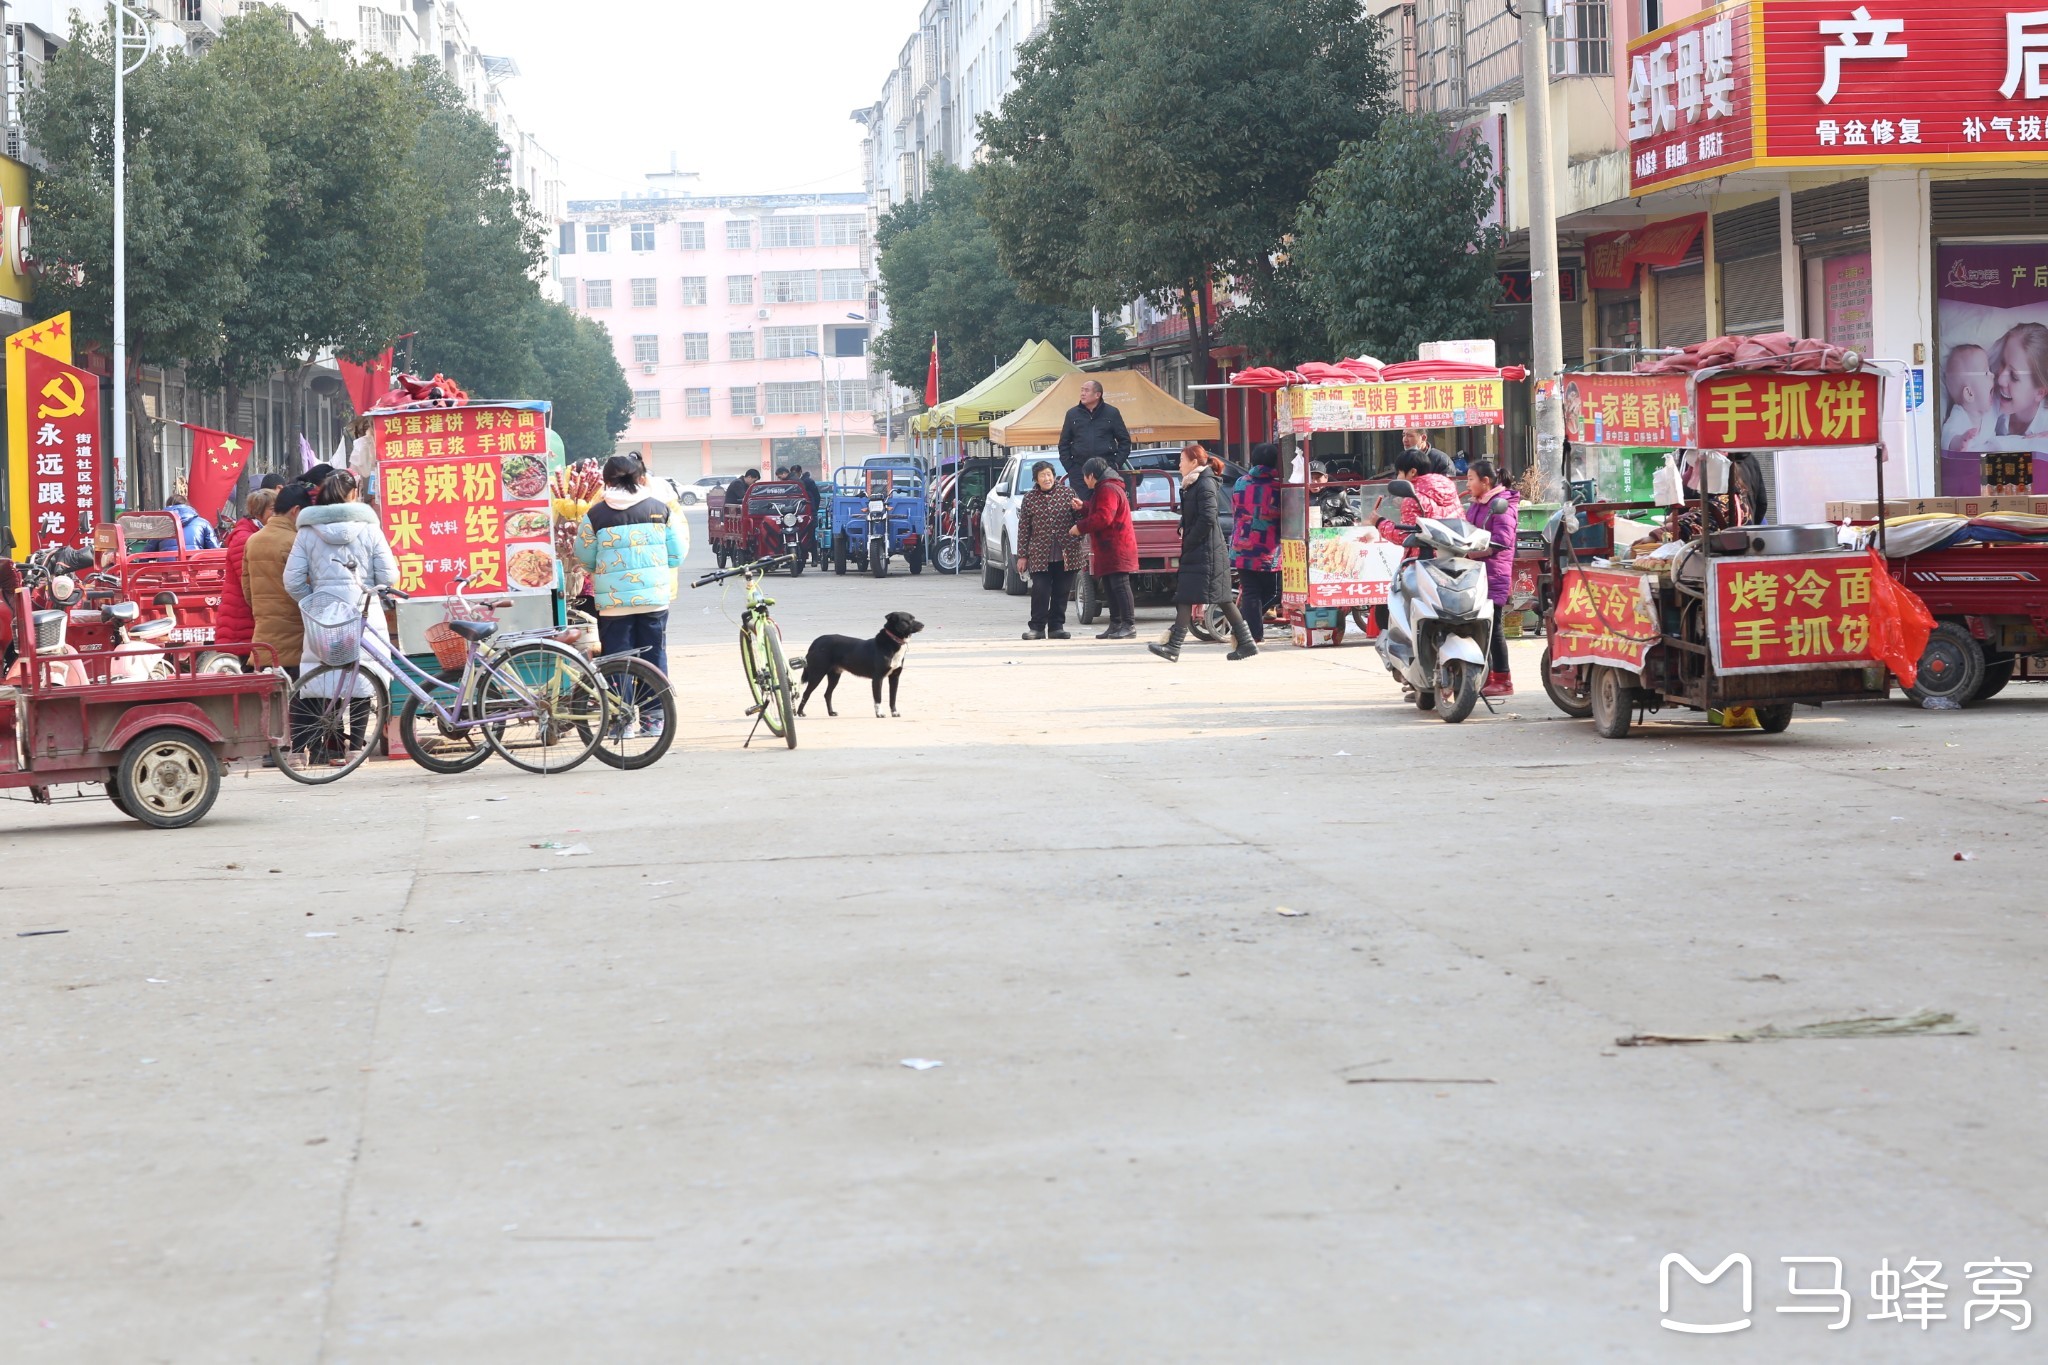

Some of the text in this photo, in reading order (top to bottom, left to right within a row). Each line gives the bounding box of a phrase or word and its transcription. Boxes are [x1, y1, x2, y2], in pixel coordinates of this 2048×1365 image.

[1815, 115, 2048, 146] 骨盆修复 补气拔
[1407, 385, 1454, 411] 手抓饼
[1463, 383, 1493, 408] 煎饼
[1582, 391, 1681, 429] 土家酱香饼
[1706, 379, 1867, 443] 手抓饼
[384, 410, 535, 435] 鸡蛋灌饼 烤冷面
[385, 431, 537, 459] 现磨豆浆 手抓饼
[385, 462, 497, 506] 酸辣粉
[389, 505, 499, 550] 米 饮料 线
[425, 557, 467, 578] 矿泉水
[469, 547, 502, 589] 皮
[1728, 567, 1872, 613] 烤冷面
[1730, 613, 1870, 661] 手抓饼
